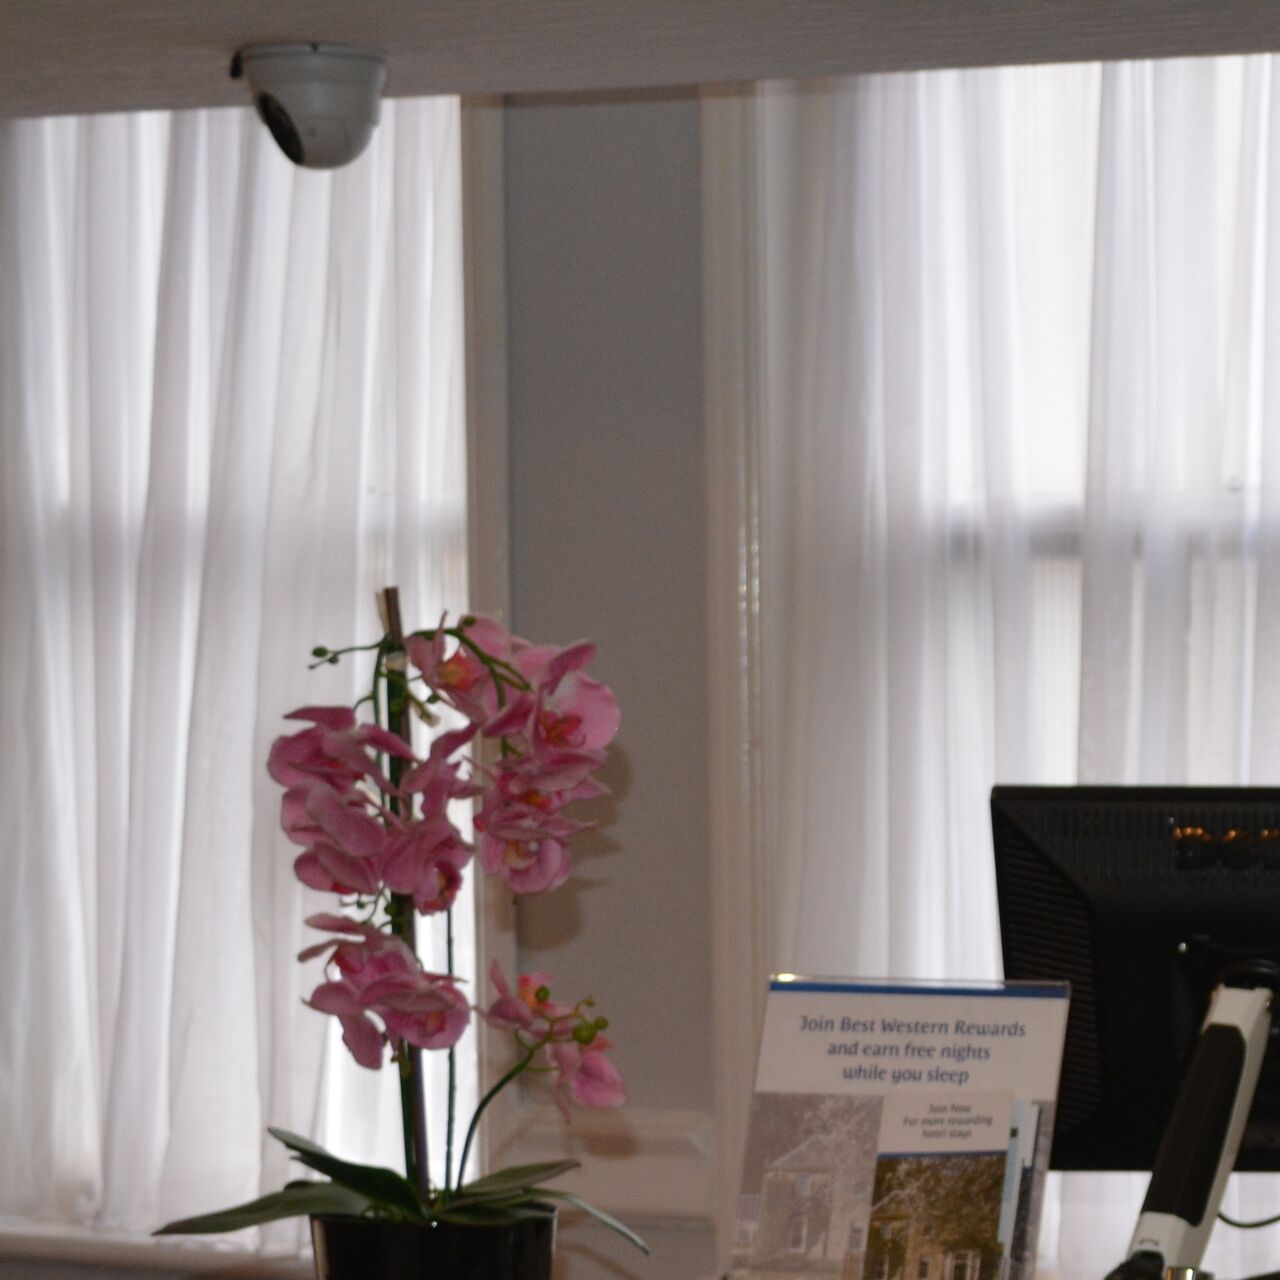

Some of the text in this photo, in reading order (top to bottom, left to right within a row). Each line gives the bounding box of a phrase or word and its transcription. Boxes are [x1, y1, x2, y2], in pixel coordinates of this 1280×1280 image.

[800, 1015, 1026, 1037] Join Best Western Rewards
[828, 1040, 991, 1063] and earn free nights
[842, 1065, 969, 1086] while you sleep
[929, 1103, 972, 1114] Join Now
[921, 1117, 945, 1127] more
[947, 1115, 993, 1128] rewarding
[922, 1128, 972, 1140] hotel stays
